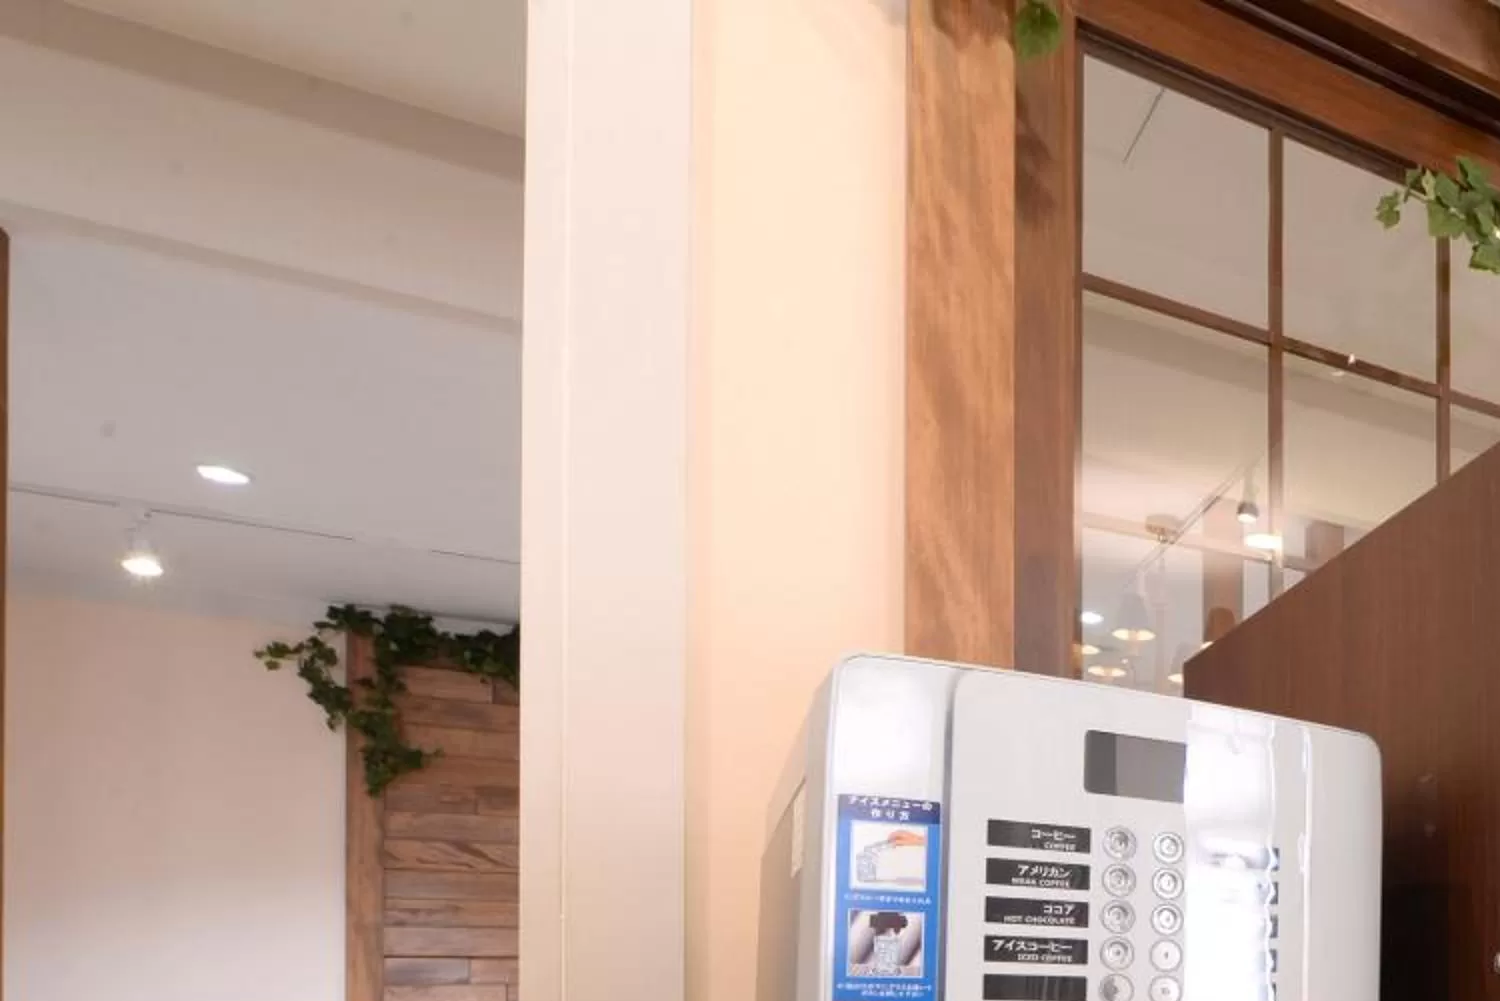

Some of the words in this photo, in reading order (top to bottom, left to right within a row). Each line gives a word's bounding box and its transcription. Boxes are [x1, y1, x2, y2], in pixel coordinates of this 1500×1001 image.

[848, 795, 933, 812] アイスメニューの
[1031, 828, 1077, 841] コーヒー
[1017, 863, 1073, 878] アメリカン
[1043, 903, 1076, 915] ココア
[991, 939, 1073, 953] アイスコーヒー
